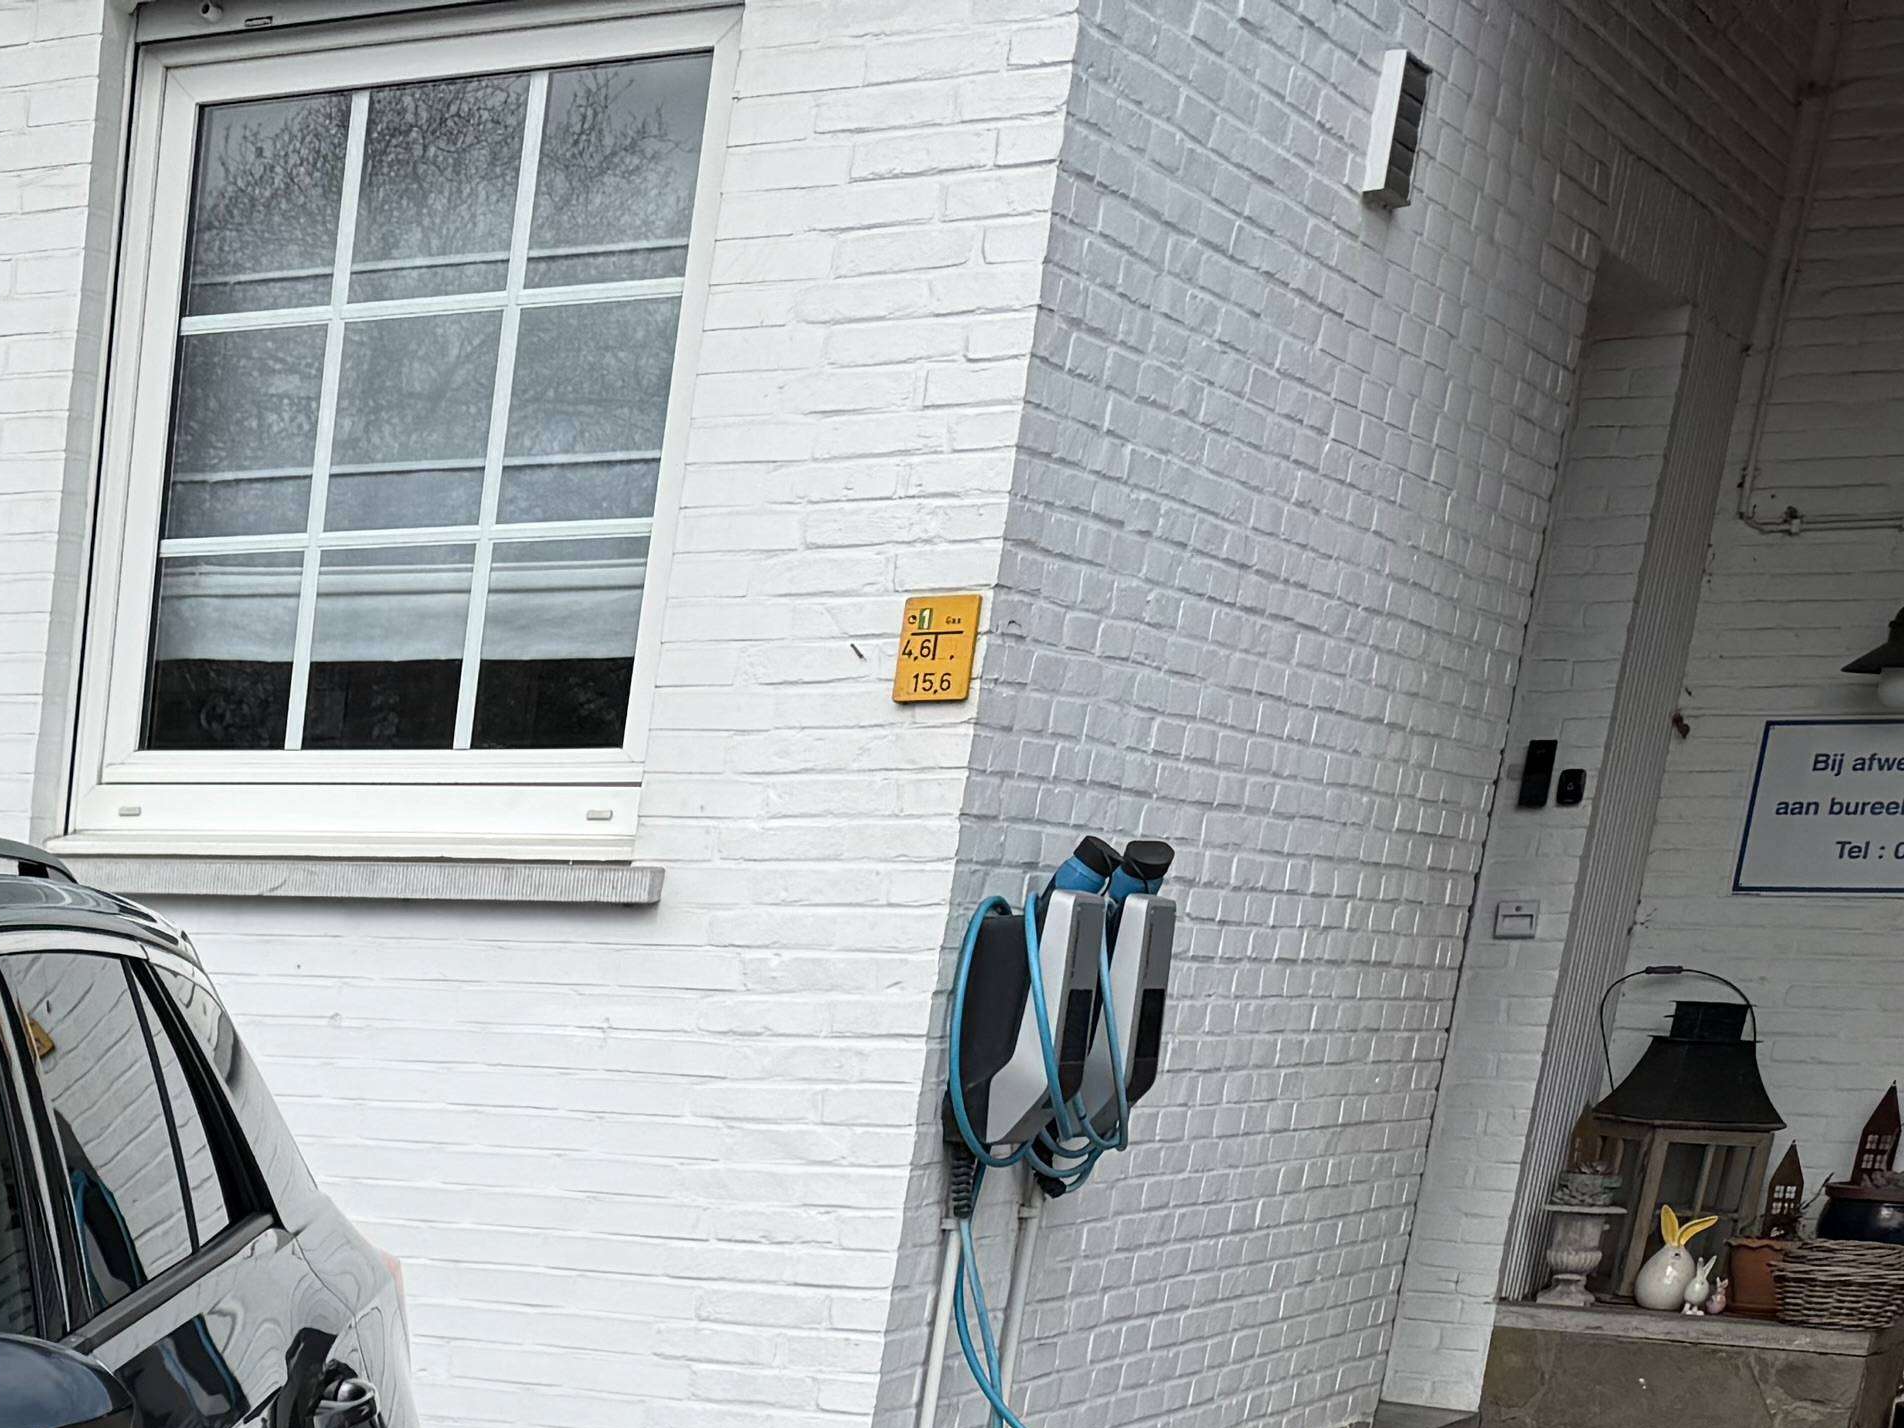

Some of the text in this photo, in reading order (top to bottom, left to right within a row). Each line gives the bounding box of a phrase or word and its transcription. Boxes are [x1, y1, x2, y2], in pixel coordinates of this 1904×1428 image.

[902, 639, 932, 662] 4,6
[912, 672, 952, 694] 15,6
[1811, 753, 1845, 777] Bij
[1775, 801, 1820, 816] aan
[1835, 841, 1870, 860] Tel
